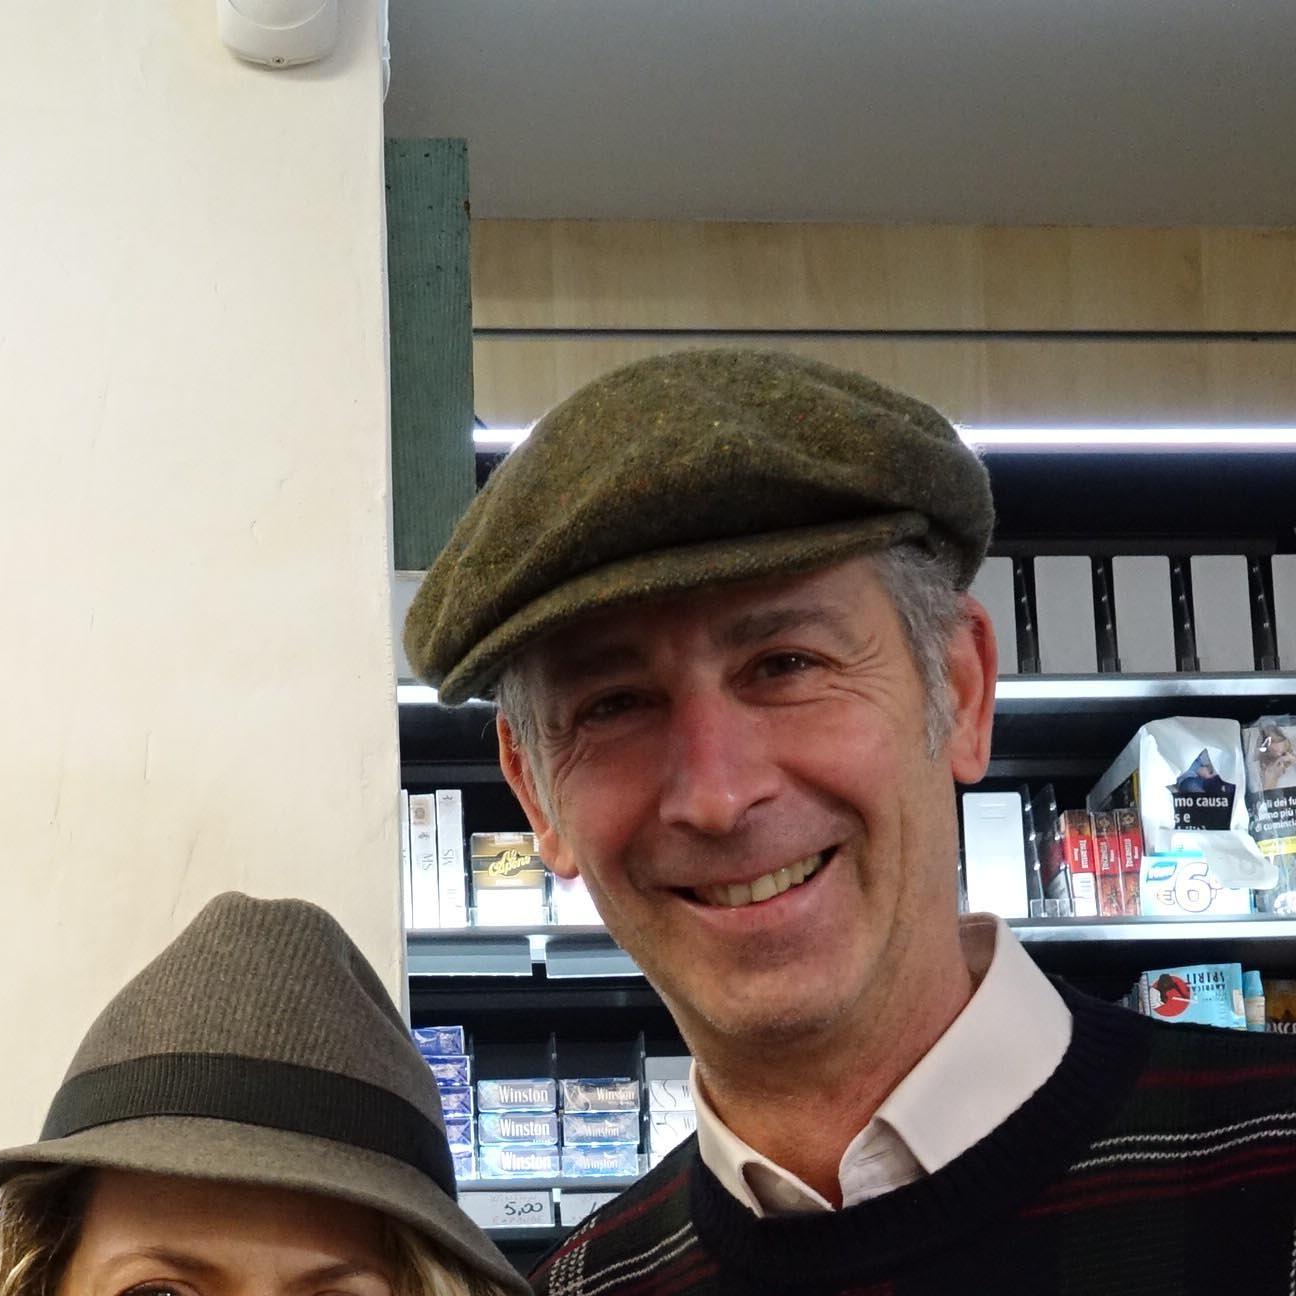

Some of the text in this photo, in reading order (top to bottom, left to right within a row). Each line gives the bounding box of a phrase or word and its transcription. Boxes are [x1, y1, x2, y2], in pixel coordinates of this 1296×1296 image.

[1196, 797, 1229, 807] causa
[1274, 797, 1287, 808] dei
[1185, 972, 1224, 985] SPIRIT
[497, 1085, 548, 1103] Winston
[596, 1086, 635, 1101] Winston
[498, 1119, 550, 1137] Winston
[583, 1124, 620, 1137] Winston
[500, 1153, 551, 1170] Winston
[582, 1157, 619, 1169] Winston
